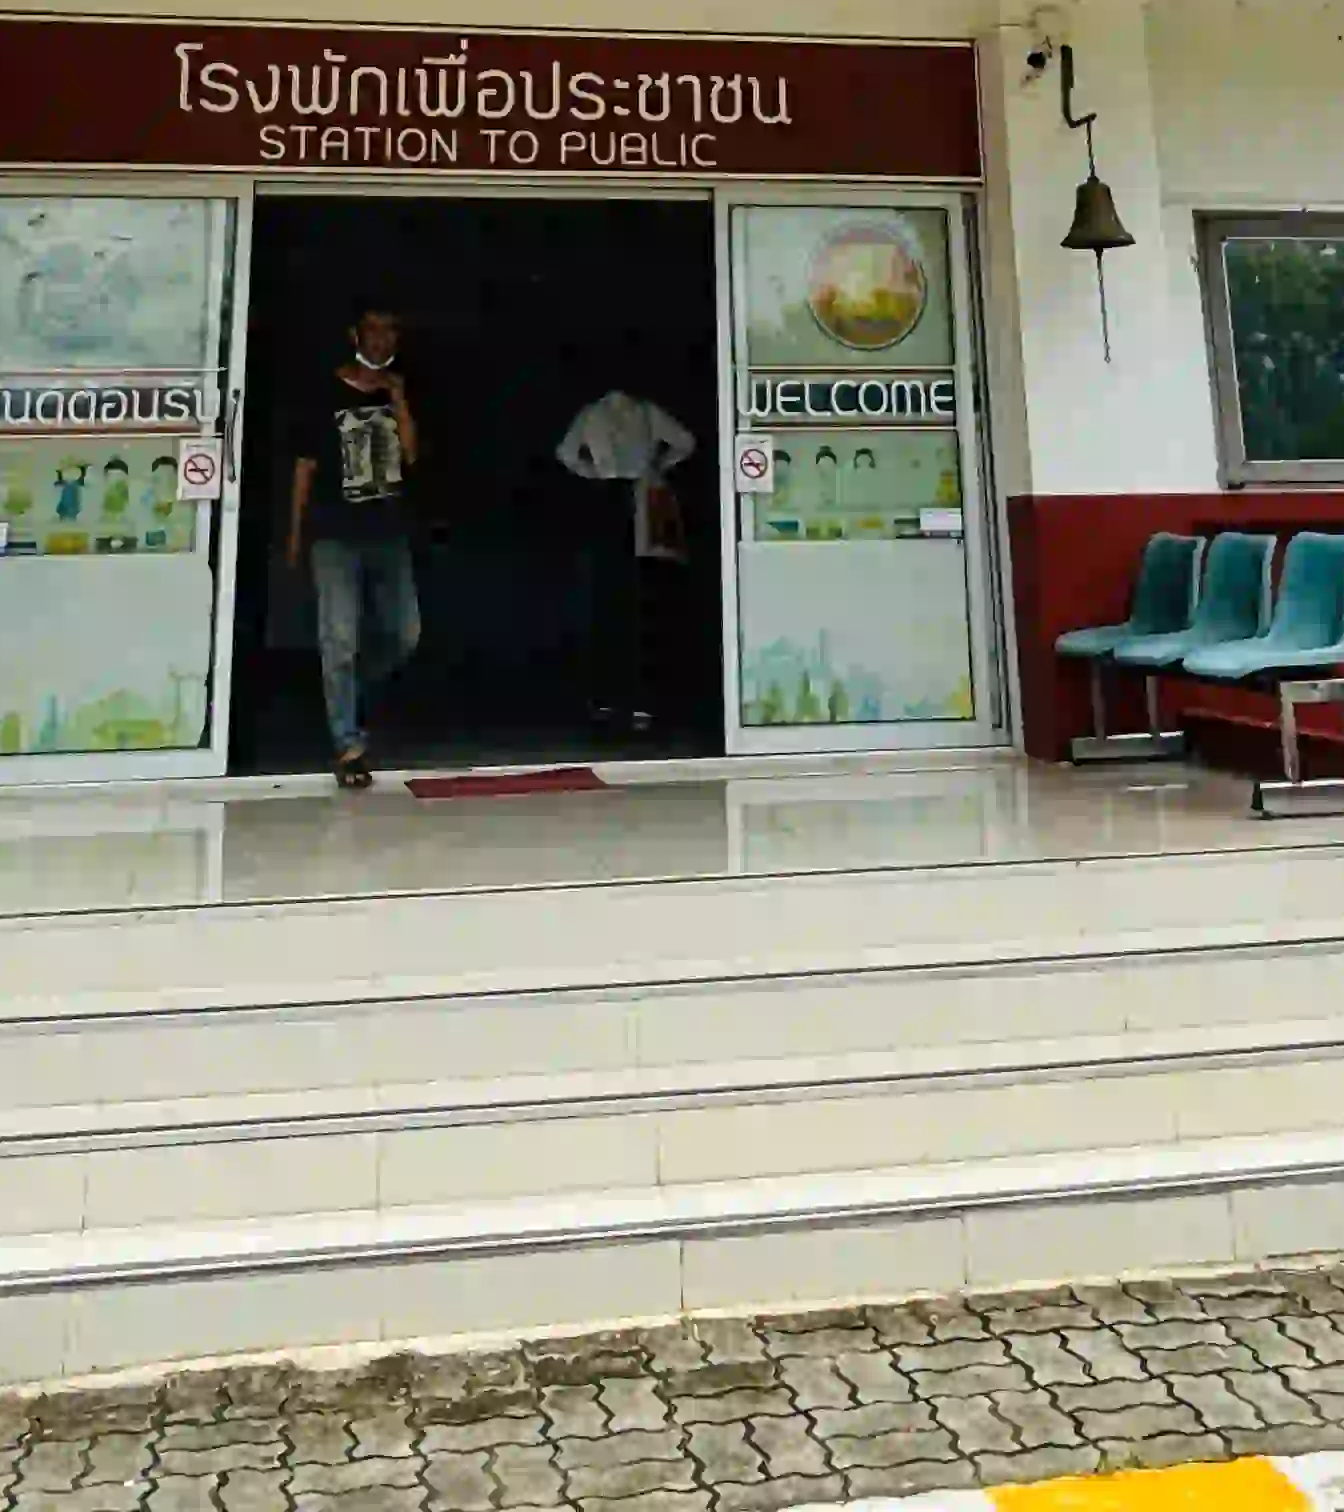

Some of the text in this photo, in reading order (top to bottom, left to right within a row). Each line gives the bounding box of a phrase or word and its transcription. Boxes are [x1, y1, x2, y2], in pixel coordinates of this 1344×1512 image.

[175, 39, 792, 125] โรงพักเพื่อประชาชน
[259, 124, 718, 167] STATION TO PUBLIC
[739, 378, 955, 419] WELCOME
